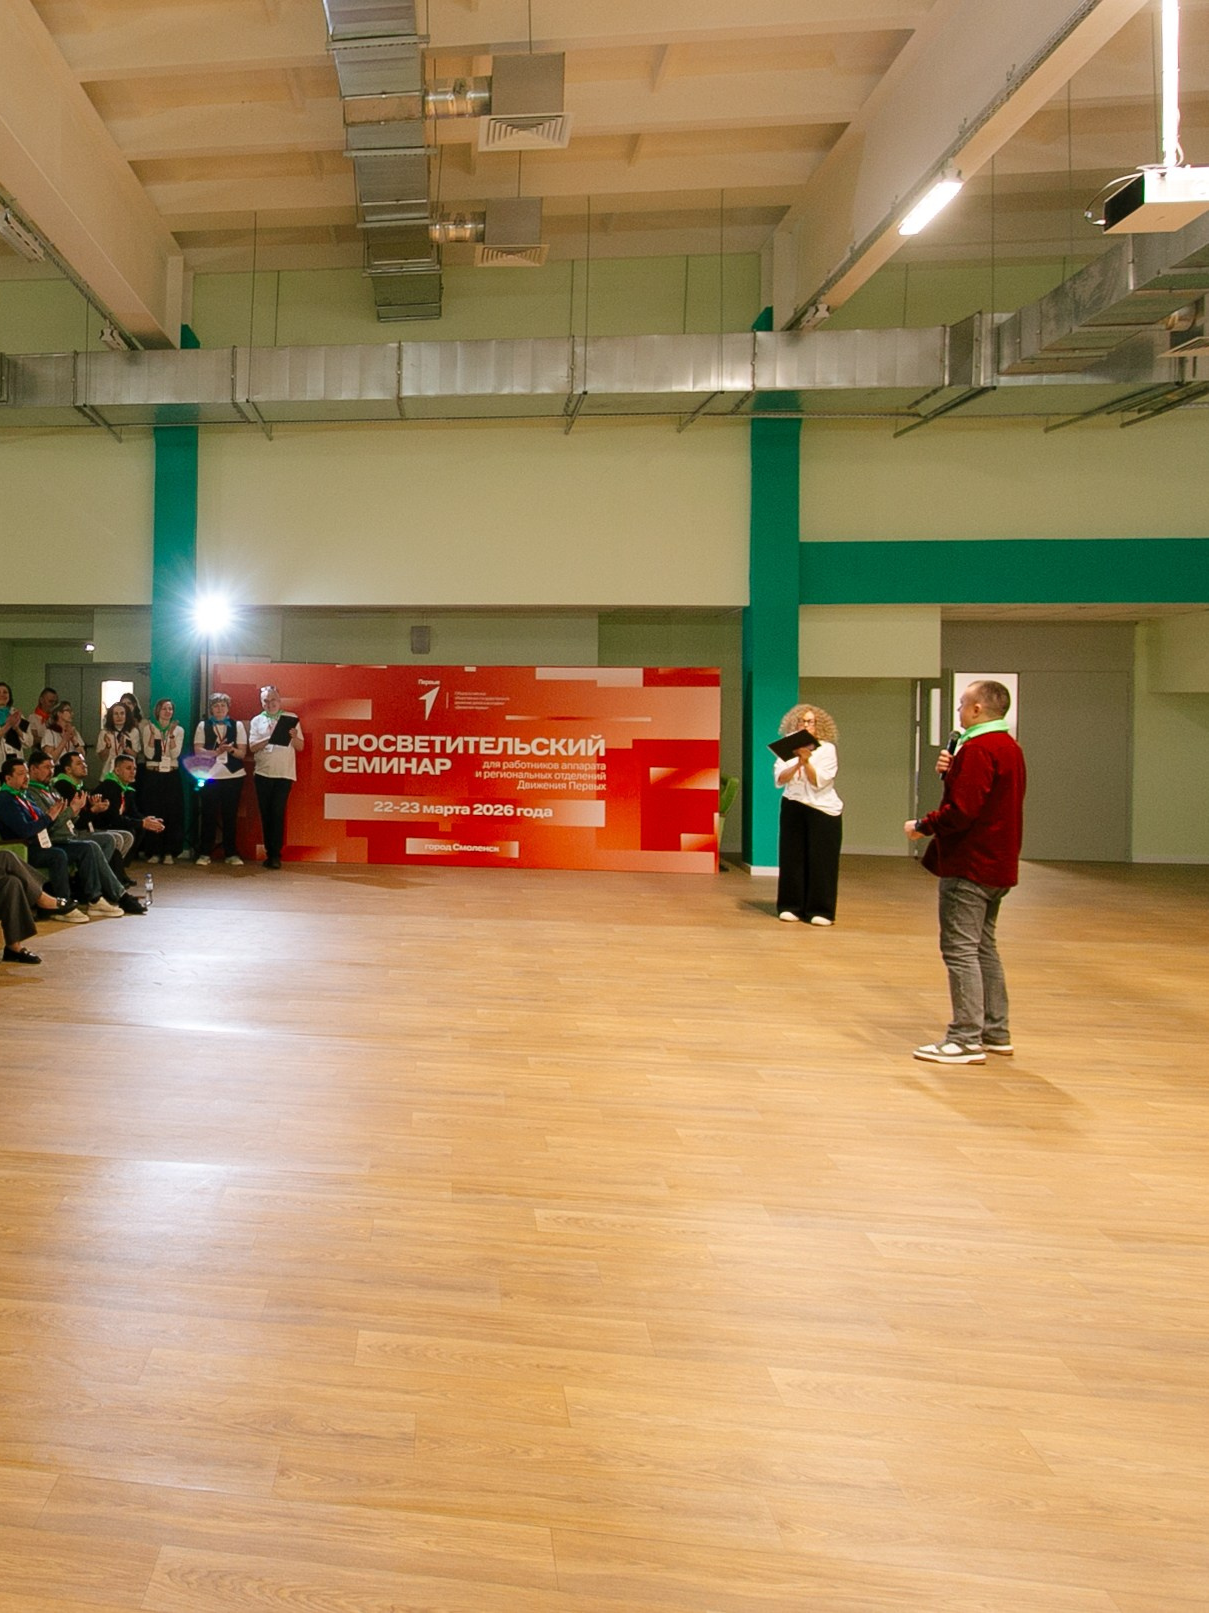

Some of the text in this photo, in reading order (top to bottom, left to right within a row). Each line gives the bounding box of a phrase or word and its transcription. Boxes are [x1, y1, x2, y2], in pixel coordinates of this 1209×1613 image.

[325, 733, 606, 757] ПРОСВЕТИТЕЛЬСКИЙ
[324, 755, 452, 776] СЕМИНАР
[482, 760, 606, 771] для работников аппарата
[483, 771, 553, 780] региональных
[553, 772, 607, 781] отделений
[516, 780, 607, 792] Движения Первых
[373, 801, 553, 818] 22-23 марта 2026 года
[425, 843, 500, 853] город Смоленск
